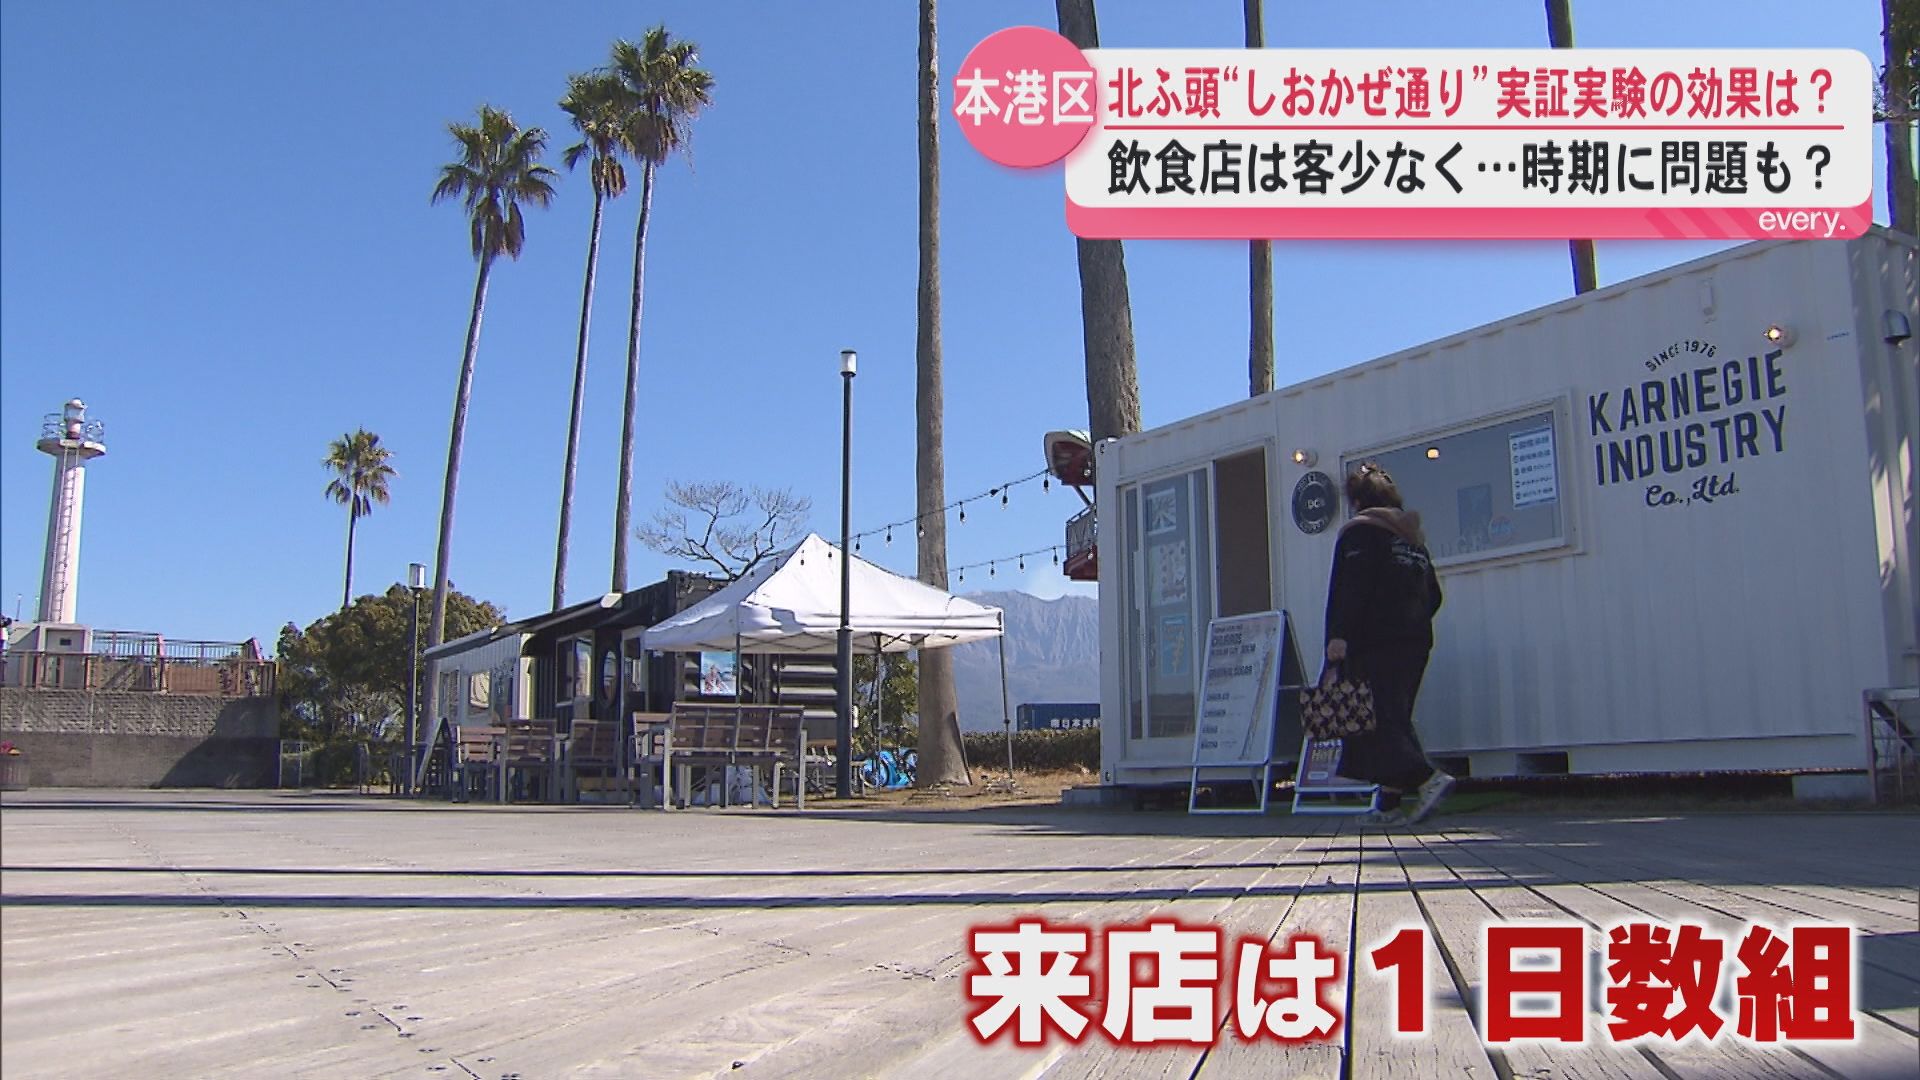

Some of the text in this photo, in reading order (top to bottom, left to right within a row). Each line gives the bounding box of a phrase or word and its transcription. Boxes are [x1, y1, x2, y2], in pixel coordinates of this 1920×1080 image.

[1589, 350, 1787, 436] KARNEGIE
[1645, 340, 1717, 372] SINCE 1976
[1595, 405, 1786, 486] INDUSTRY
